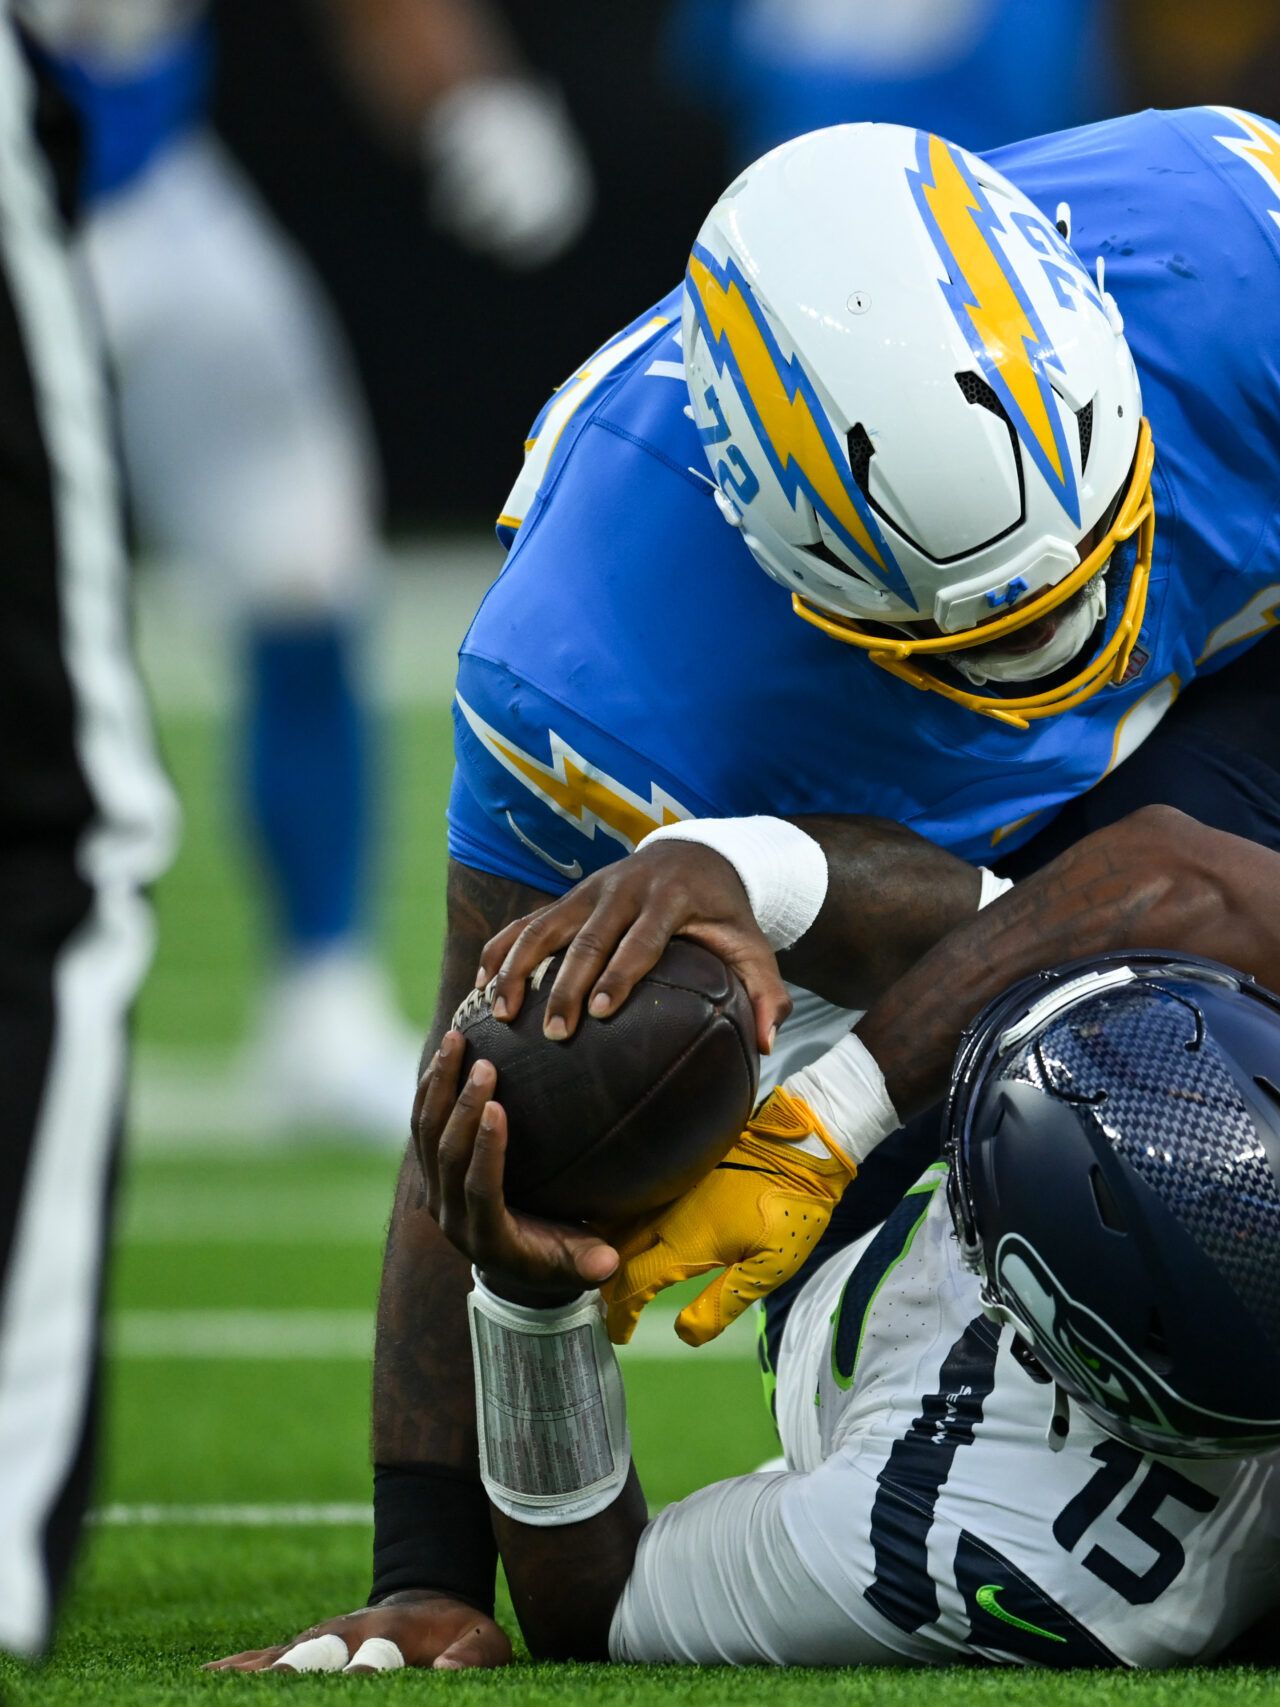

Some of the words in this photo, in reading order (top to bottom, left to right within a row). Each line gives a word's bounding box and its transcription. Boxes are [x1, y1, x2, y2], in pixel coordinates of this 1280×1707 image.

[698, 384, 760, 518] 72
[985, 576, 1029, 609] LA
[1052, 1437, 1220, 1606] 15
